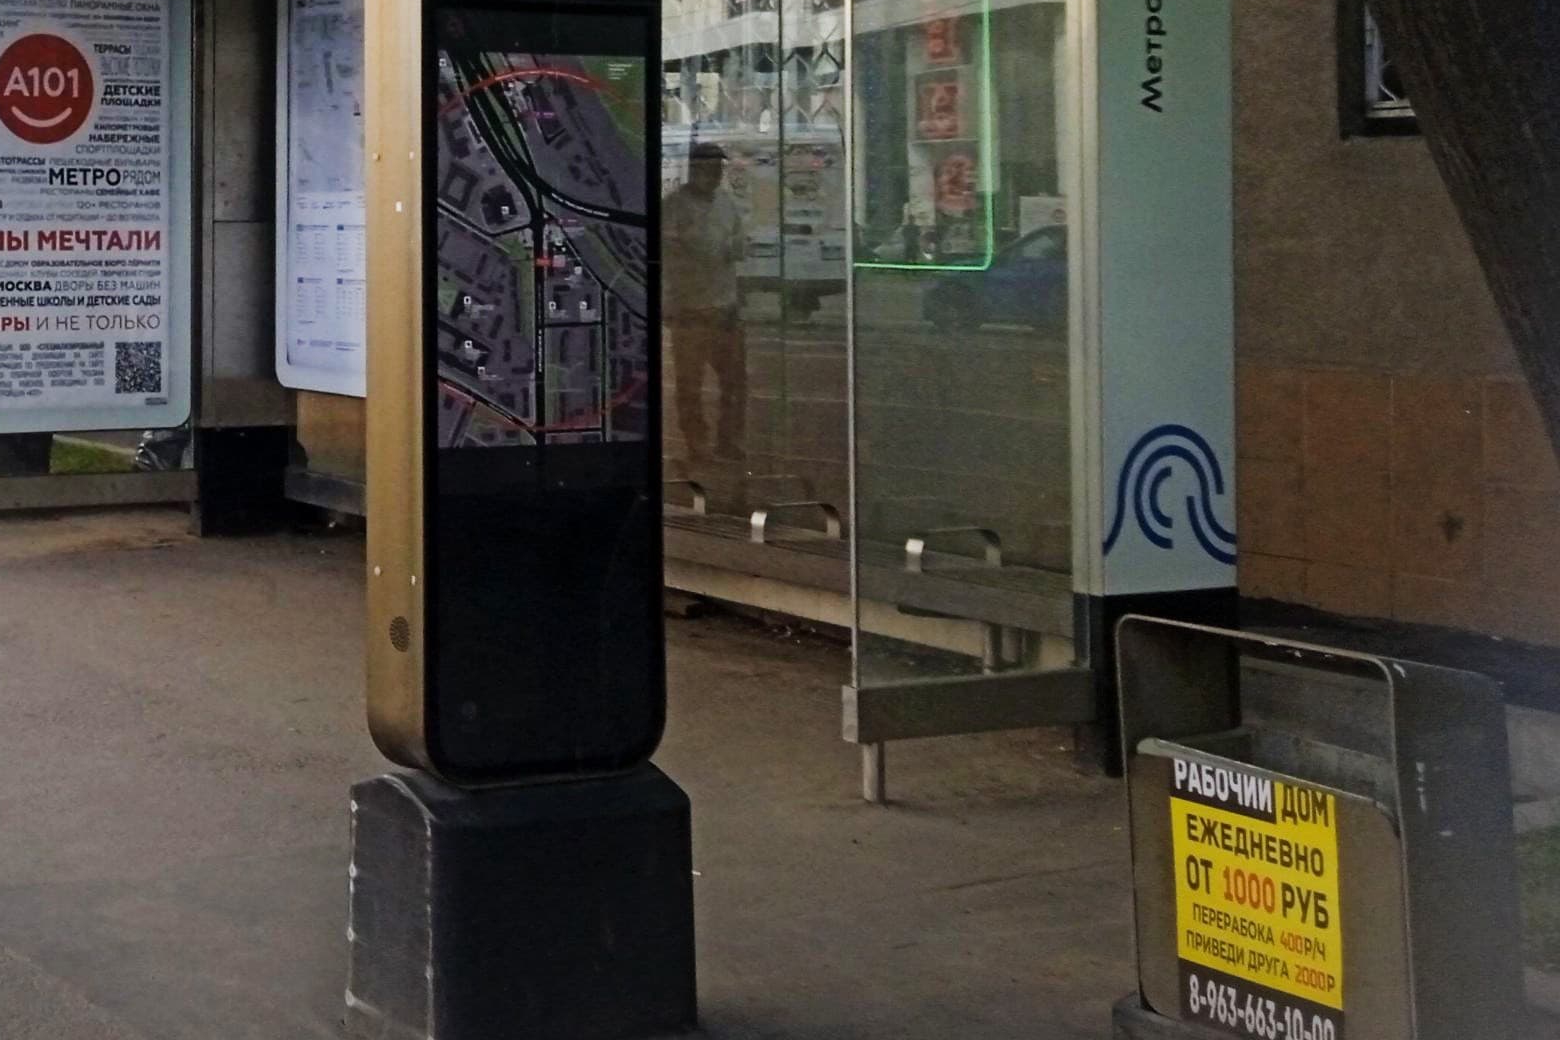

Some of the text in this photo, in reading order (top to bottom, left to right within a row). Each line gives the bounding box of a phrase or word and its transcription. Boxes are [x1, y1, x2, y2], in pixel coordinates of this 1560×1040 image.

[93, 43, 132, 55] ТЕРРАСЫ
[3, 65, 80, 98] А101
[103, 84, 161, 97] ДЕТСКИЕ
[100, 97, 161, 107] ПЛОЩАДКИ
[88, 133, 160, 144] НАБЕРЕЖНЫЕ
[75, 144, 161, 155] СПОРТПЛОЩАДКИ
[48, 167, 121, 186] МЕТРО
[122, 171, 161, 186] РЯДОМ
[36, 230, 161, 251] МЕЧТАЛИ
[54, 280, 95, 292] ДВОРЫ
[96, 280, 118, 290] БЕЗ
[120, 279, 161, 290] МАШИН
[36, 296, 76, 307] ШКОЛЫ
[77, 297, 85, 306] И
[86, 296, 131, 308] ДЕТСКИЕ
[132, 296, 161, 307] САДЫ
[36, 317, 49, 331] И
[56, 316, 81, 331] НЕ
[86, 314, 161, 331] ТОЛЬКО
[1281, 783, 1330, 828] ДОМ
[1186, 813, 1325, 878] ЕЖЕДНЕВНО
[1185, 854, 1330, 929] ОТ 1000 РУБ
[1192, 902, 1327, 962] ПЕРЕРАБОКА 400Р/Ч
[1186, 929, 1336, 993] ПРИВЕДИ ДРУГА 2000Р
